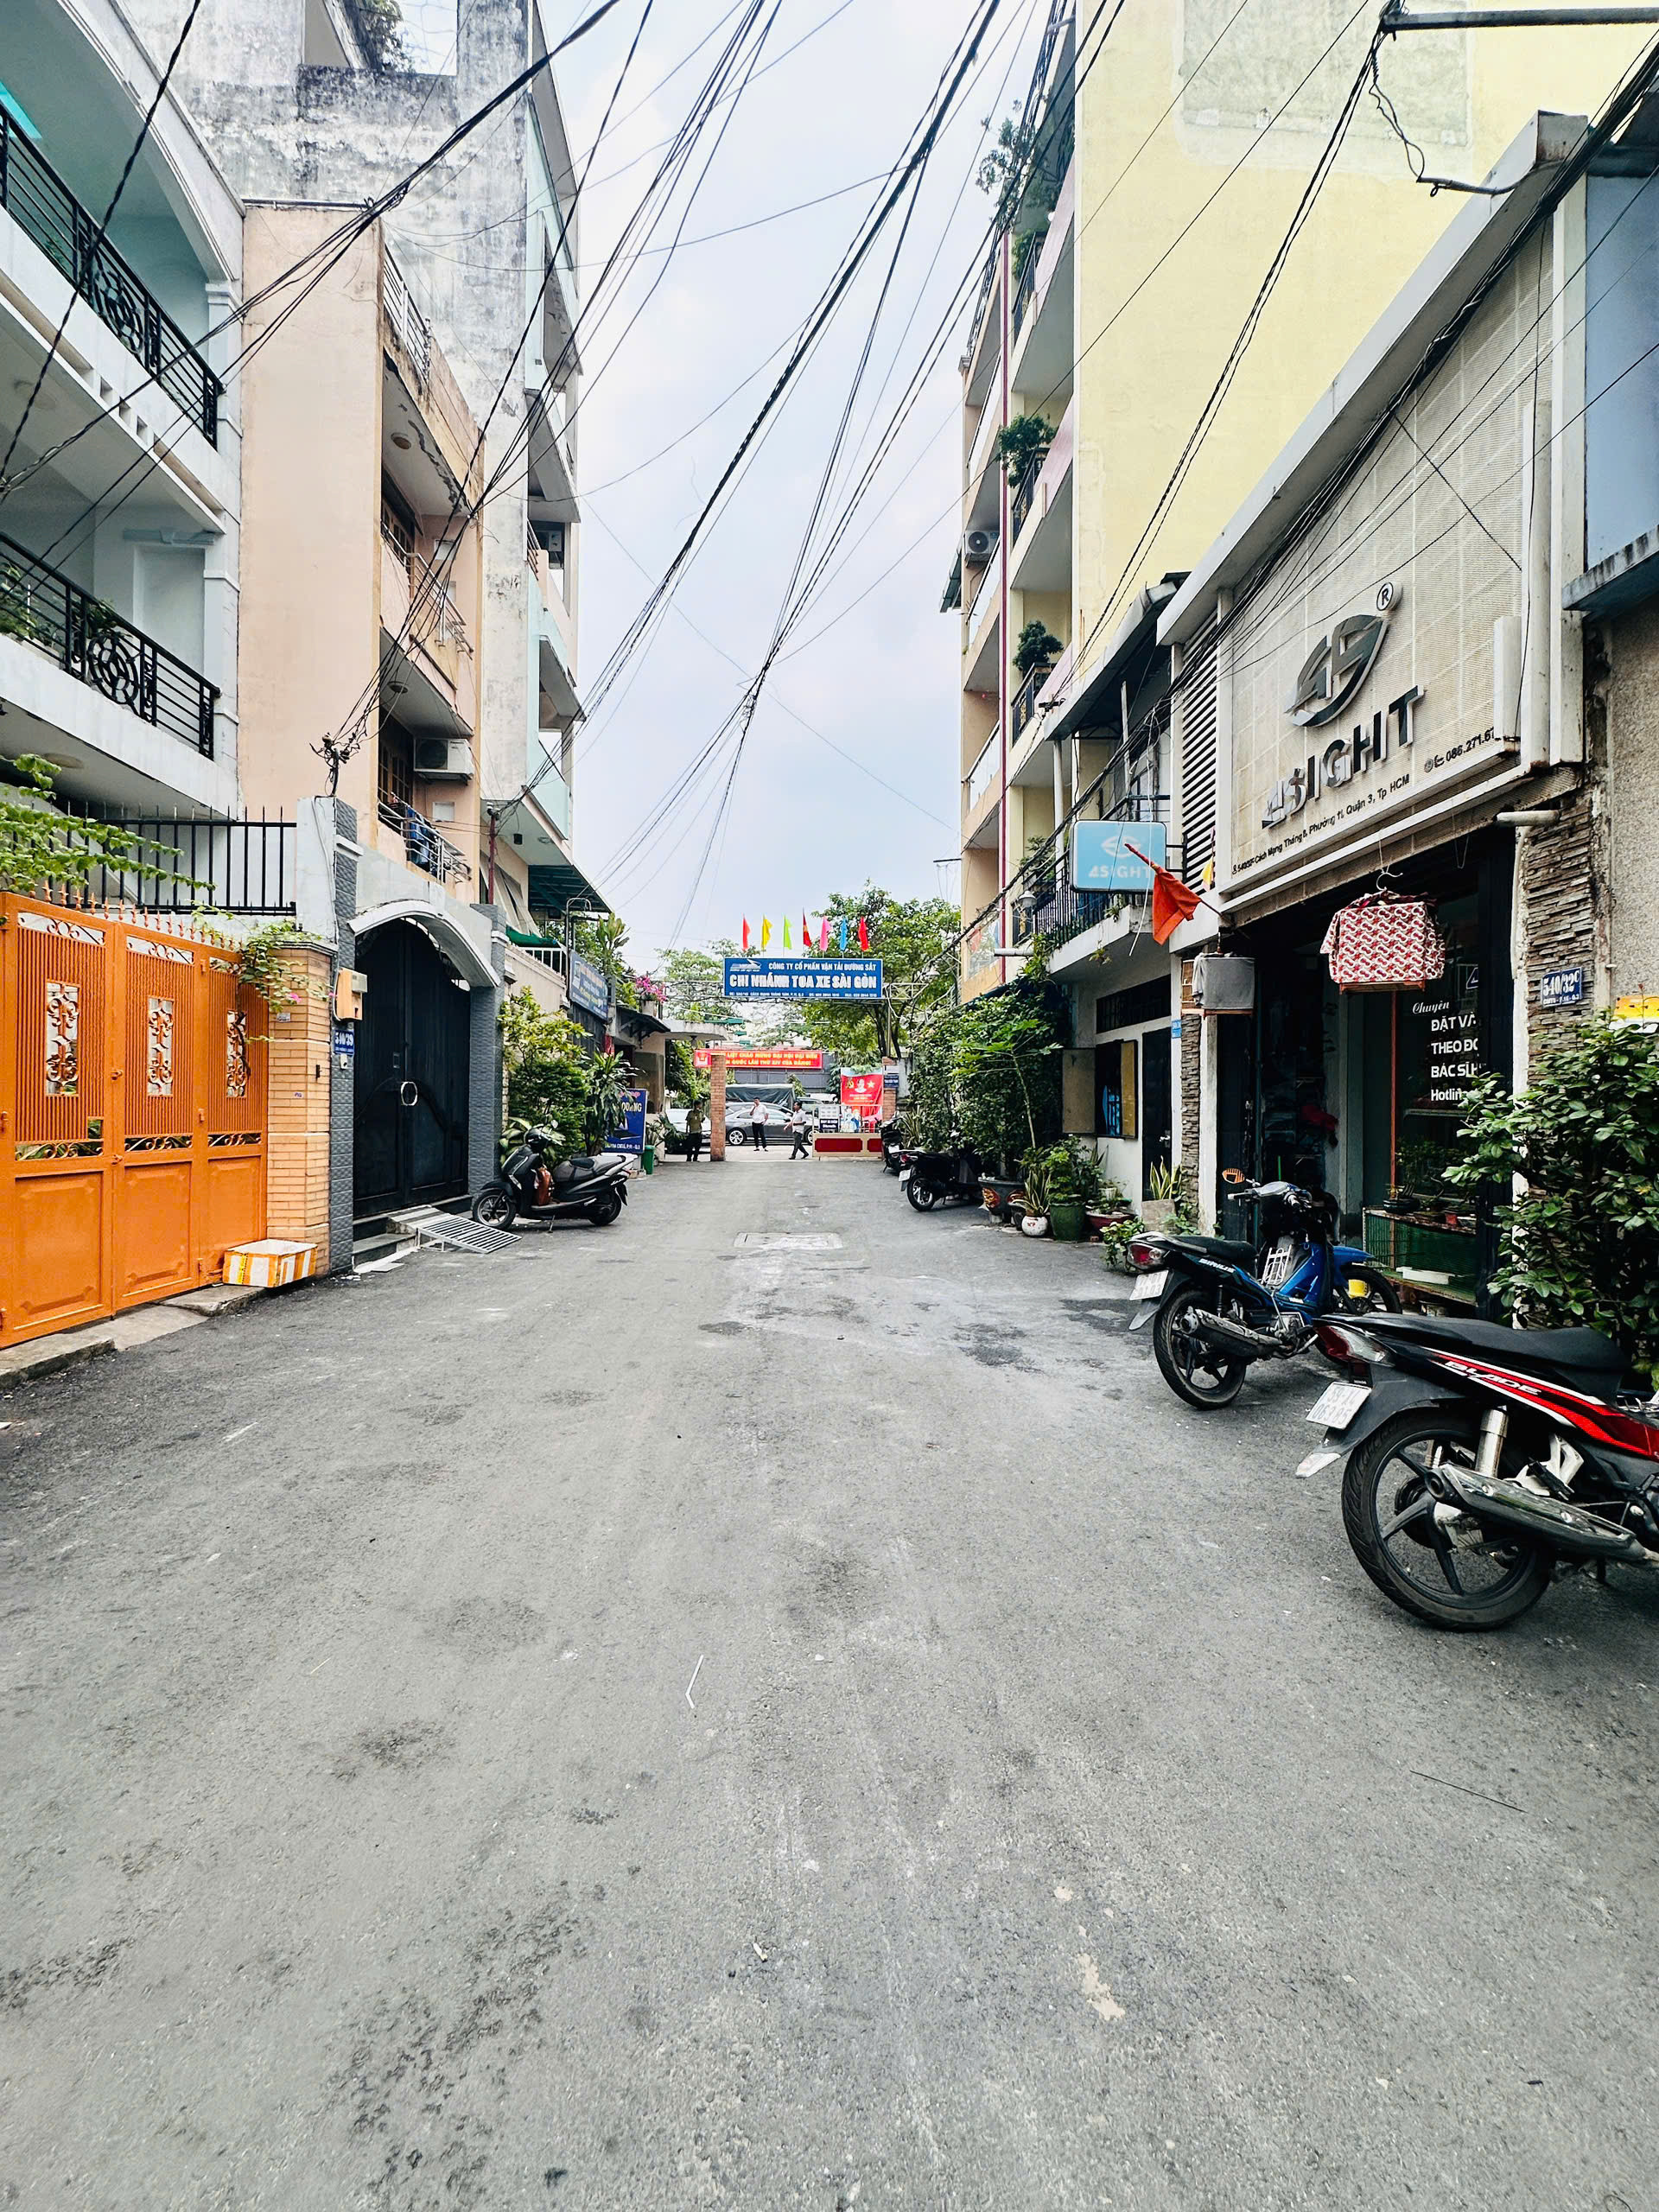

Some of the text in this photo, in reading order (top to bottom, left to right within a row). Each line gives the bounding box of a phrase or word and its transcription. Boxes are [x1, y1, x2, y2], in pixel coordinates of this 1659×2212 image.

[1389, 774, 1410, 792] HCM
[729, 972, 876, 988] CHI NHÁNH TOA XE SÀI GÒN
[1412, 1000, 1450, 1014] Chuyên
[1431, 1015, 1457, 1033] ĐẶT
[1430, 1039, 1462, 1055] THEO
[1431, 1062, 1456, 1078] BÁC
